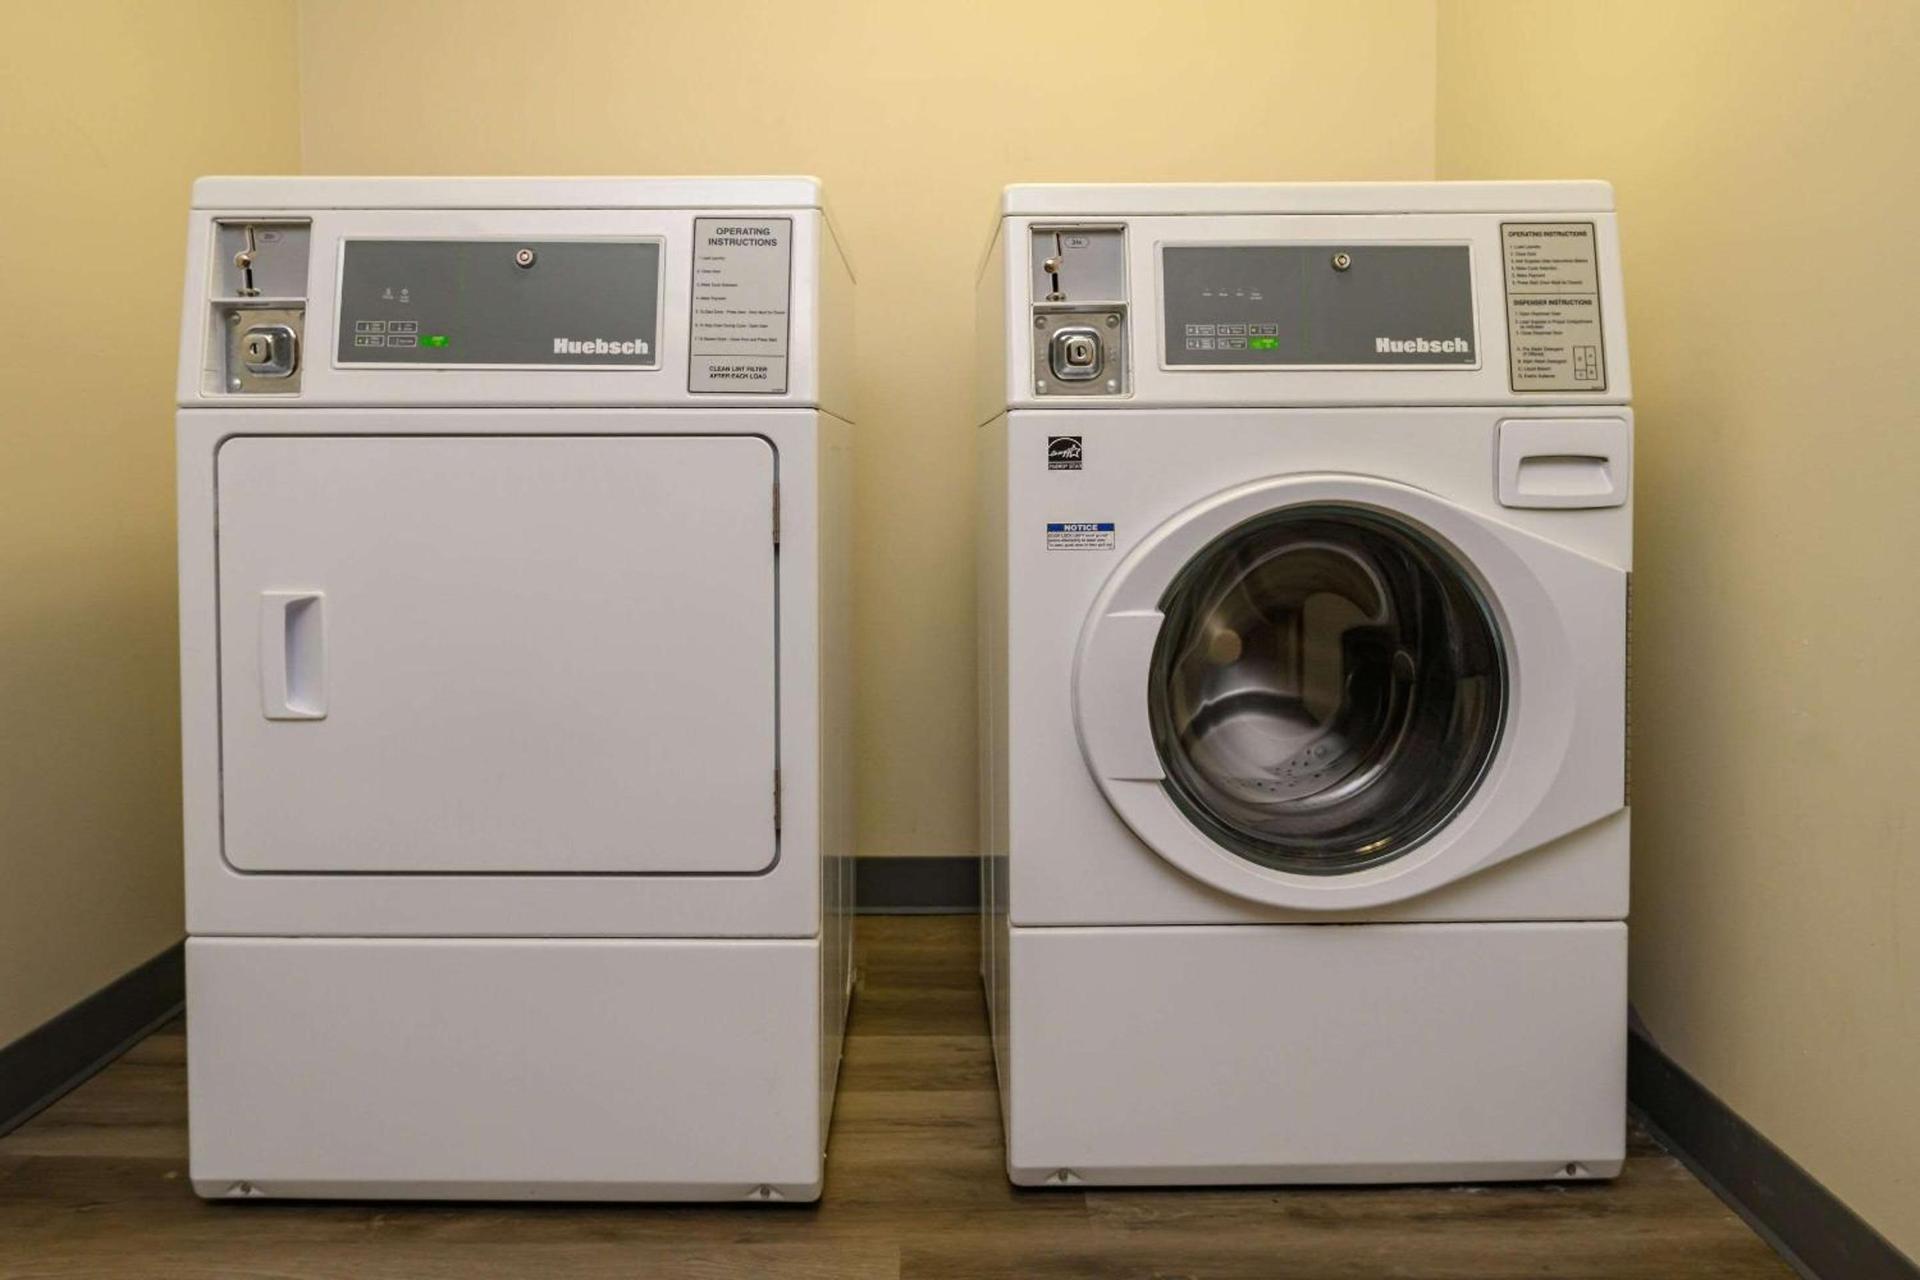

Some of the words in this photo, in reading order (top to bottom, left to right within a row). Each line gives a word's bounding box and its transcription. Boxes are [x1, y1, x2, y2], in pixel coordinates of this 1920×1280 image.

[716, 227, 771, 236] OPERATING
[708, 238, 778, 247] INSTRUCTIONS
[553, 338, 649, 355] Huebsch
[1375, 337, 1469, 353] Huebsch
